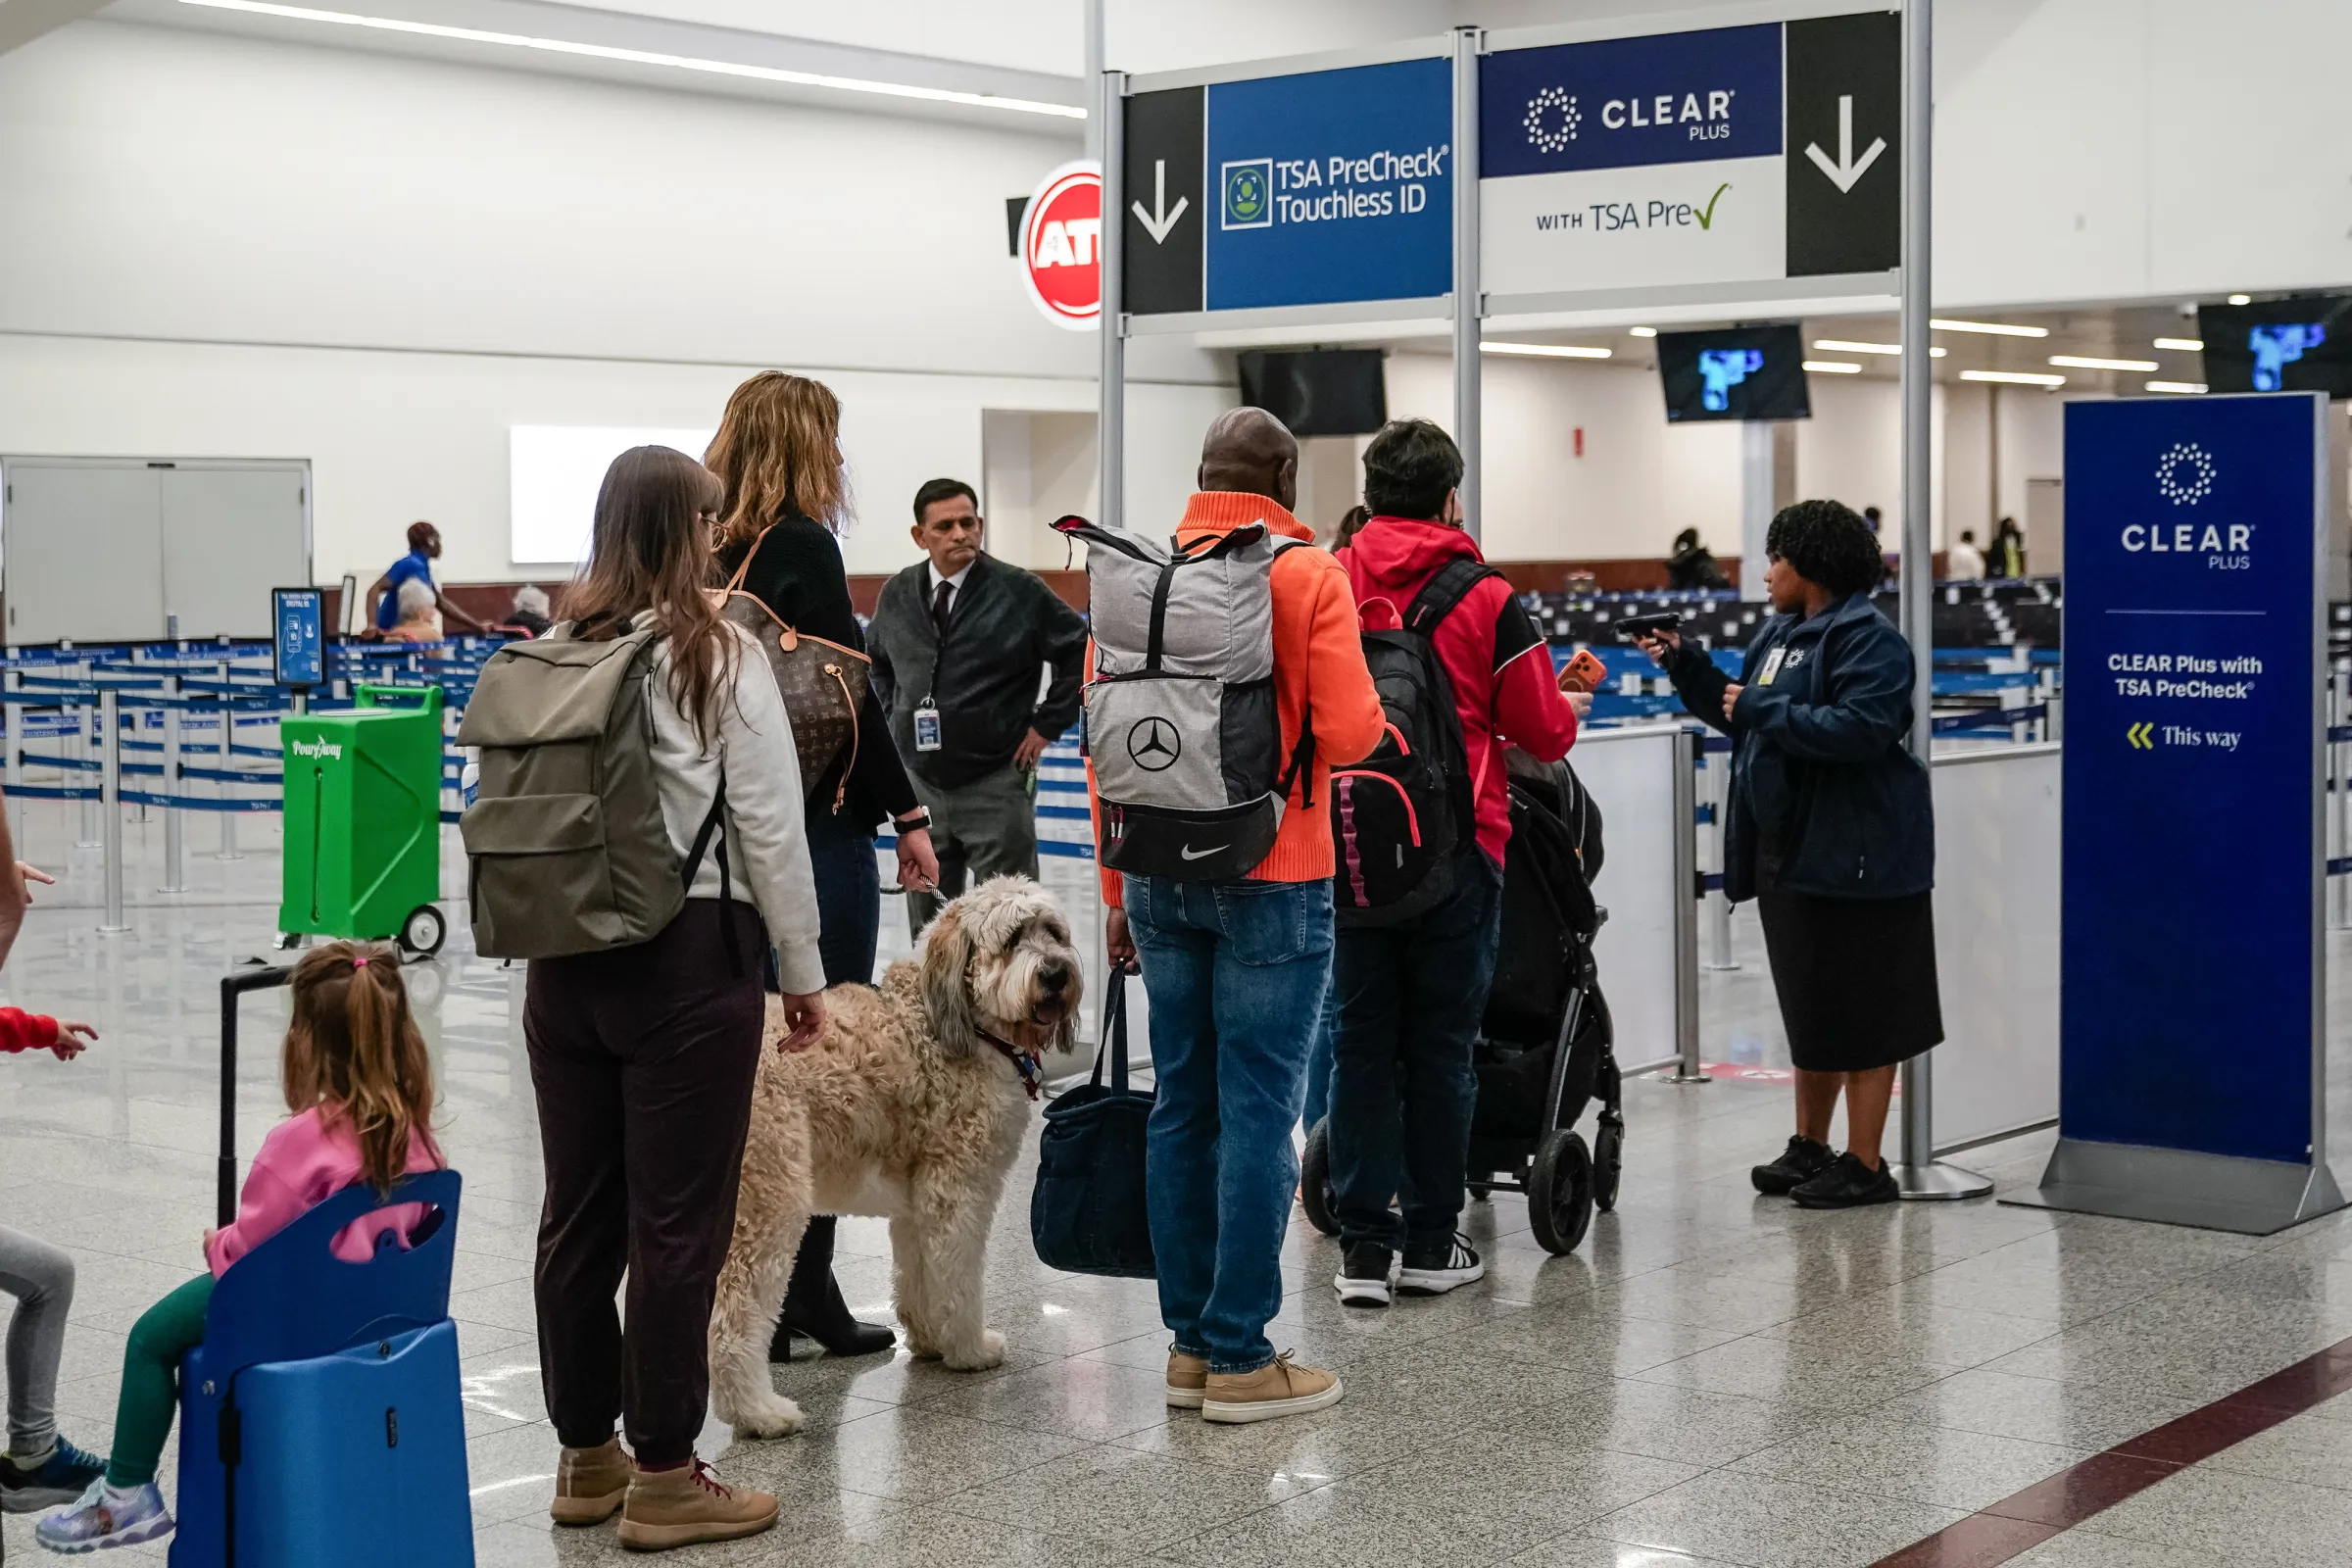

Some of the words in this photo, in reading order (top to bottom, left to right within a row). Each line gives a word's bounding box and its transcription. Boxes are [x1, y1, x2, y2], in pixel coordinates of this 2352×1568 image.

[1690, 123, 1731, 141] PLUS
[1276, 159, 1323, 190] TSA
[1276, 188, 1394, 224] Touchless
[1399, 183, 1427, 215] ID
[1537, 213, 1584, 231] WITH
[1589, 202, 1641, 232] TSA
[1035, 217, 1102, 269] AT
[2208, 555, 2251, 569] PLUS
[2108, 654, 2173, 672] CLEAR
[2176, 655, 2218, 673] Plus
[2220, 656, 2263, 674] with
[2115, 678, 2153, 696] TSA
[2162, 725, 2202, 746] This
[2205, 731, 2241, 752] way
